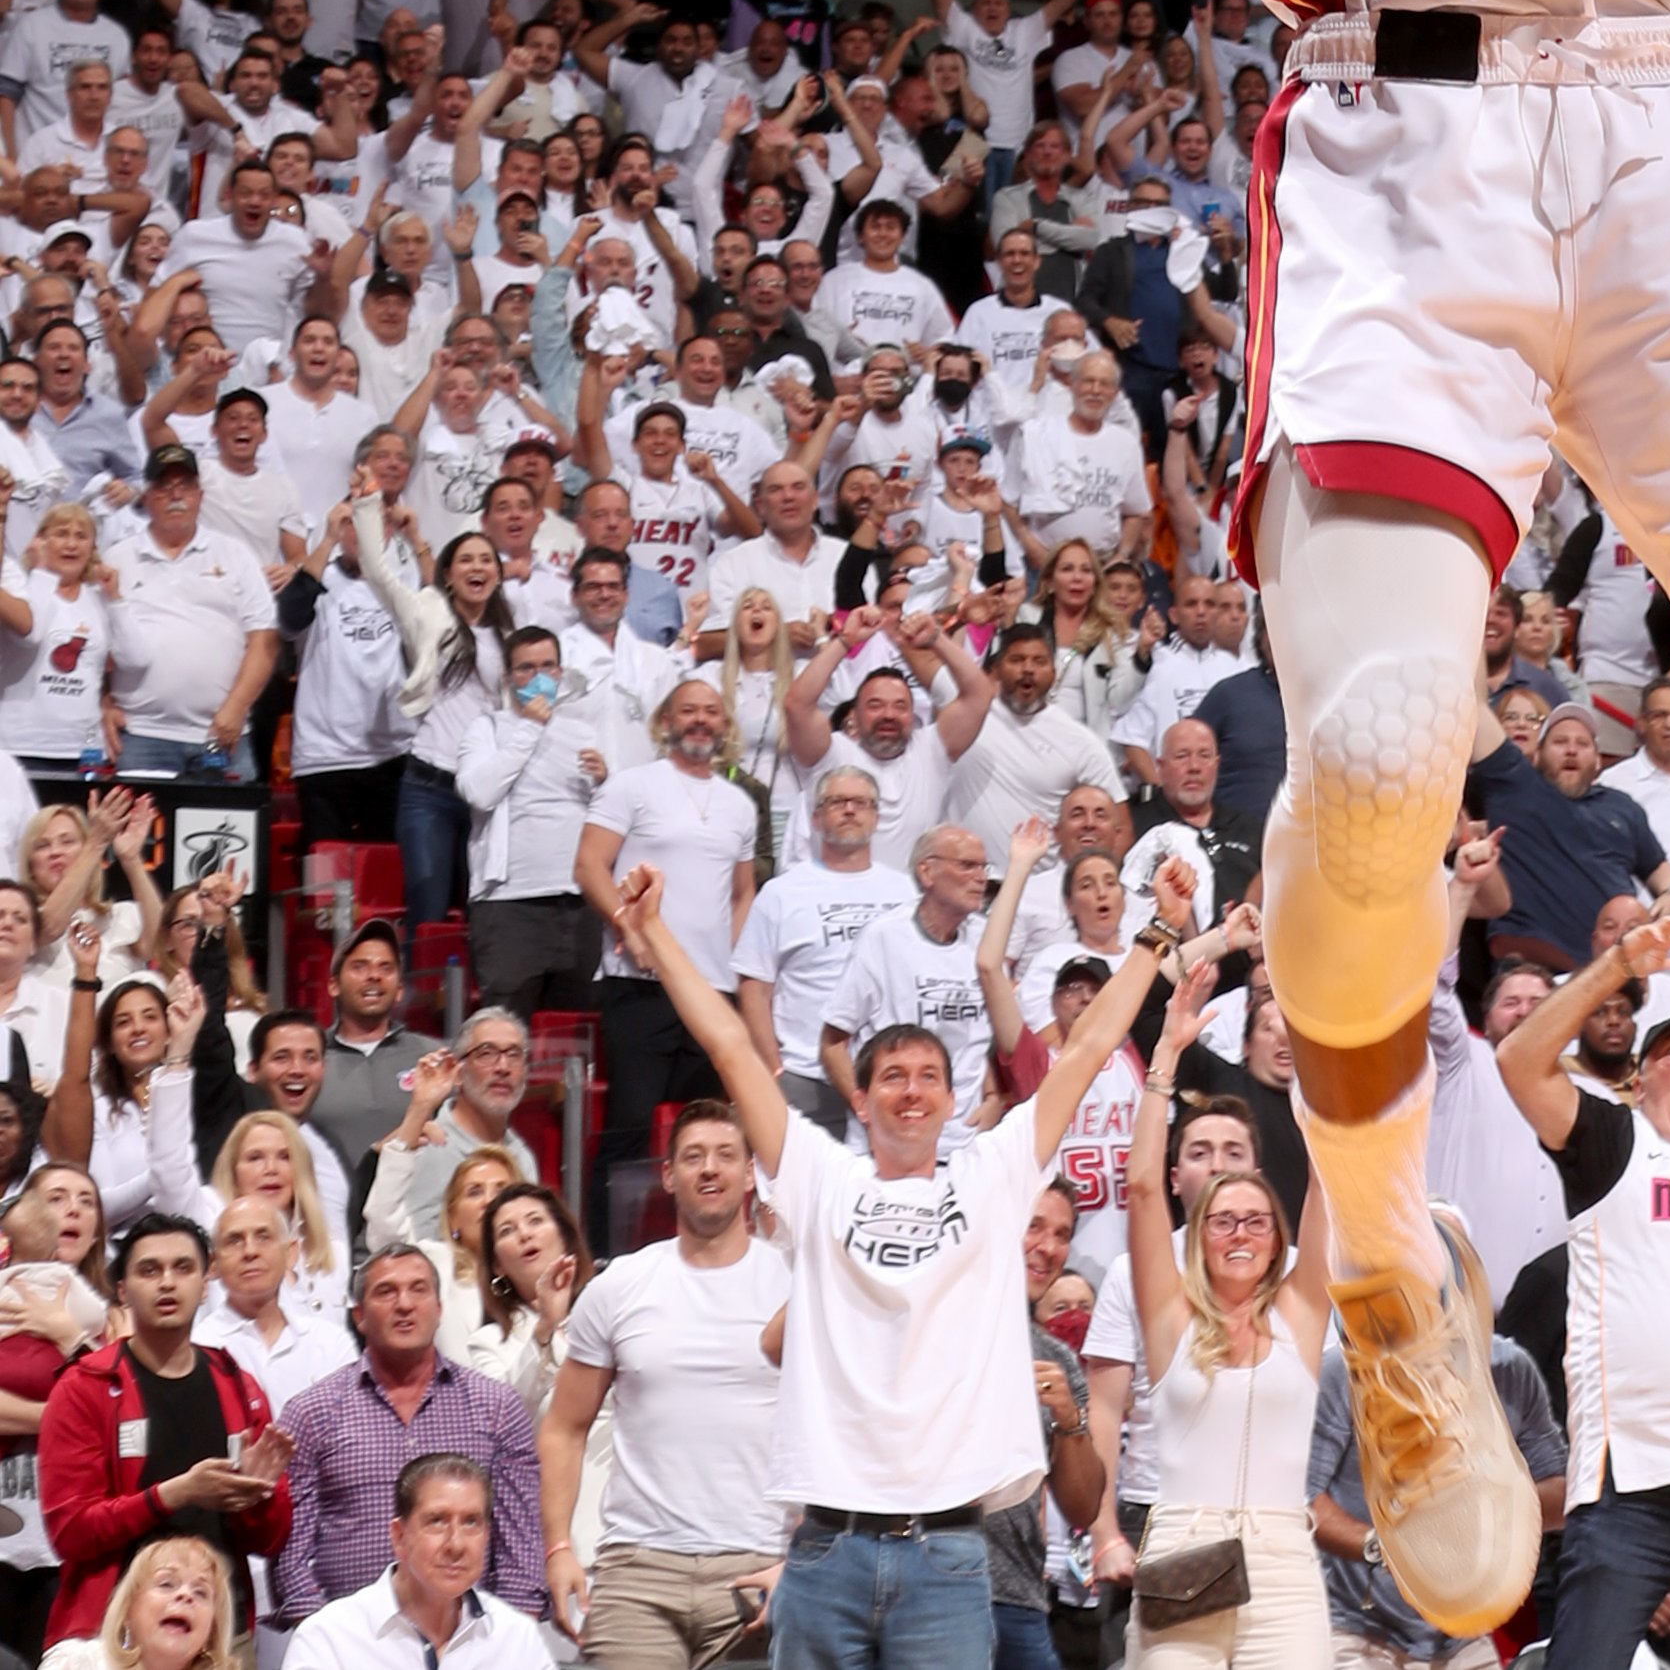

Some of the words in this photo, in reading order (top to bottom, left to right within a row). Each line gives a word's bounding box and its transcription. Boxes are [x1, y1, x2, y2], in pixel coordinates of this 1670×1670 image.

[629, 517, 699, 546] HEAT
[657, 555, 694, 587] 22
[40, 674, 84, 685] MIAMI
[47, 685, 87, 697] HEAT
